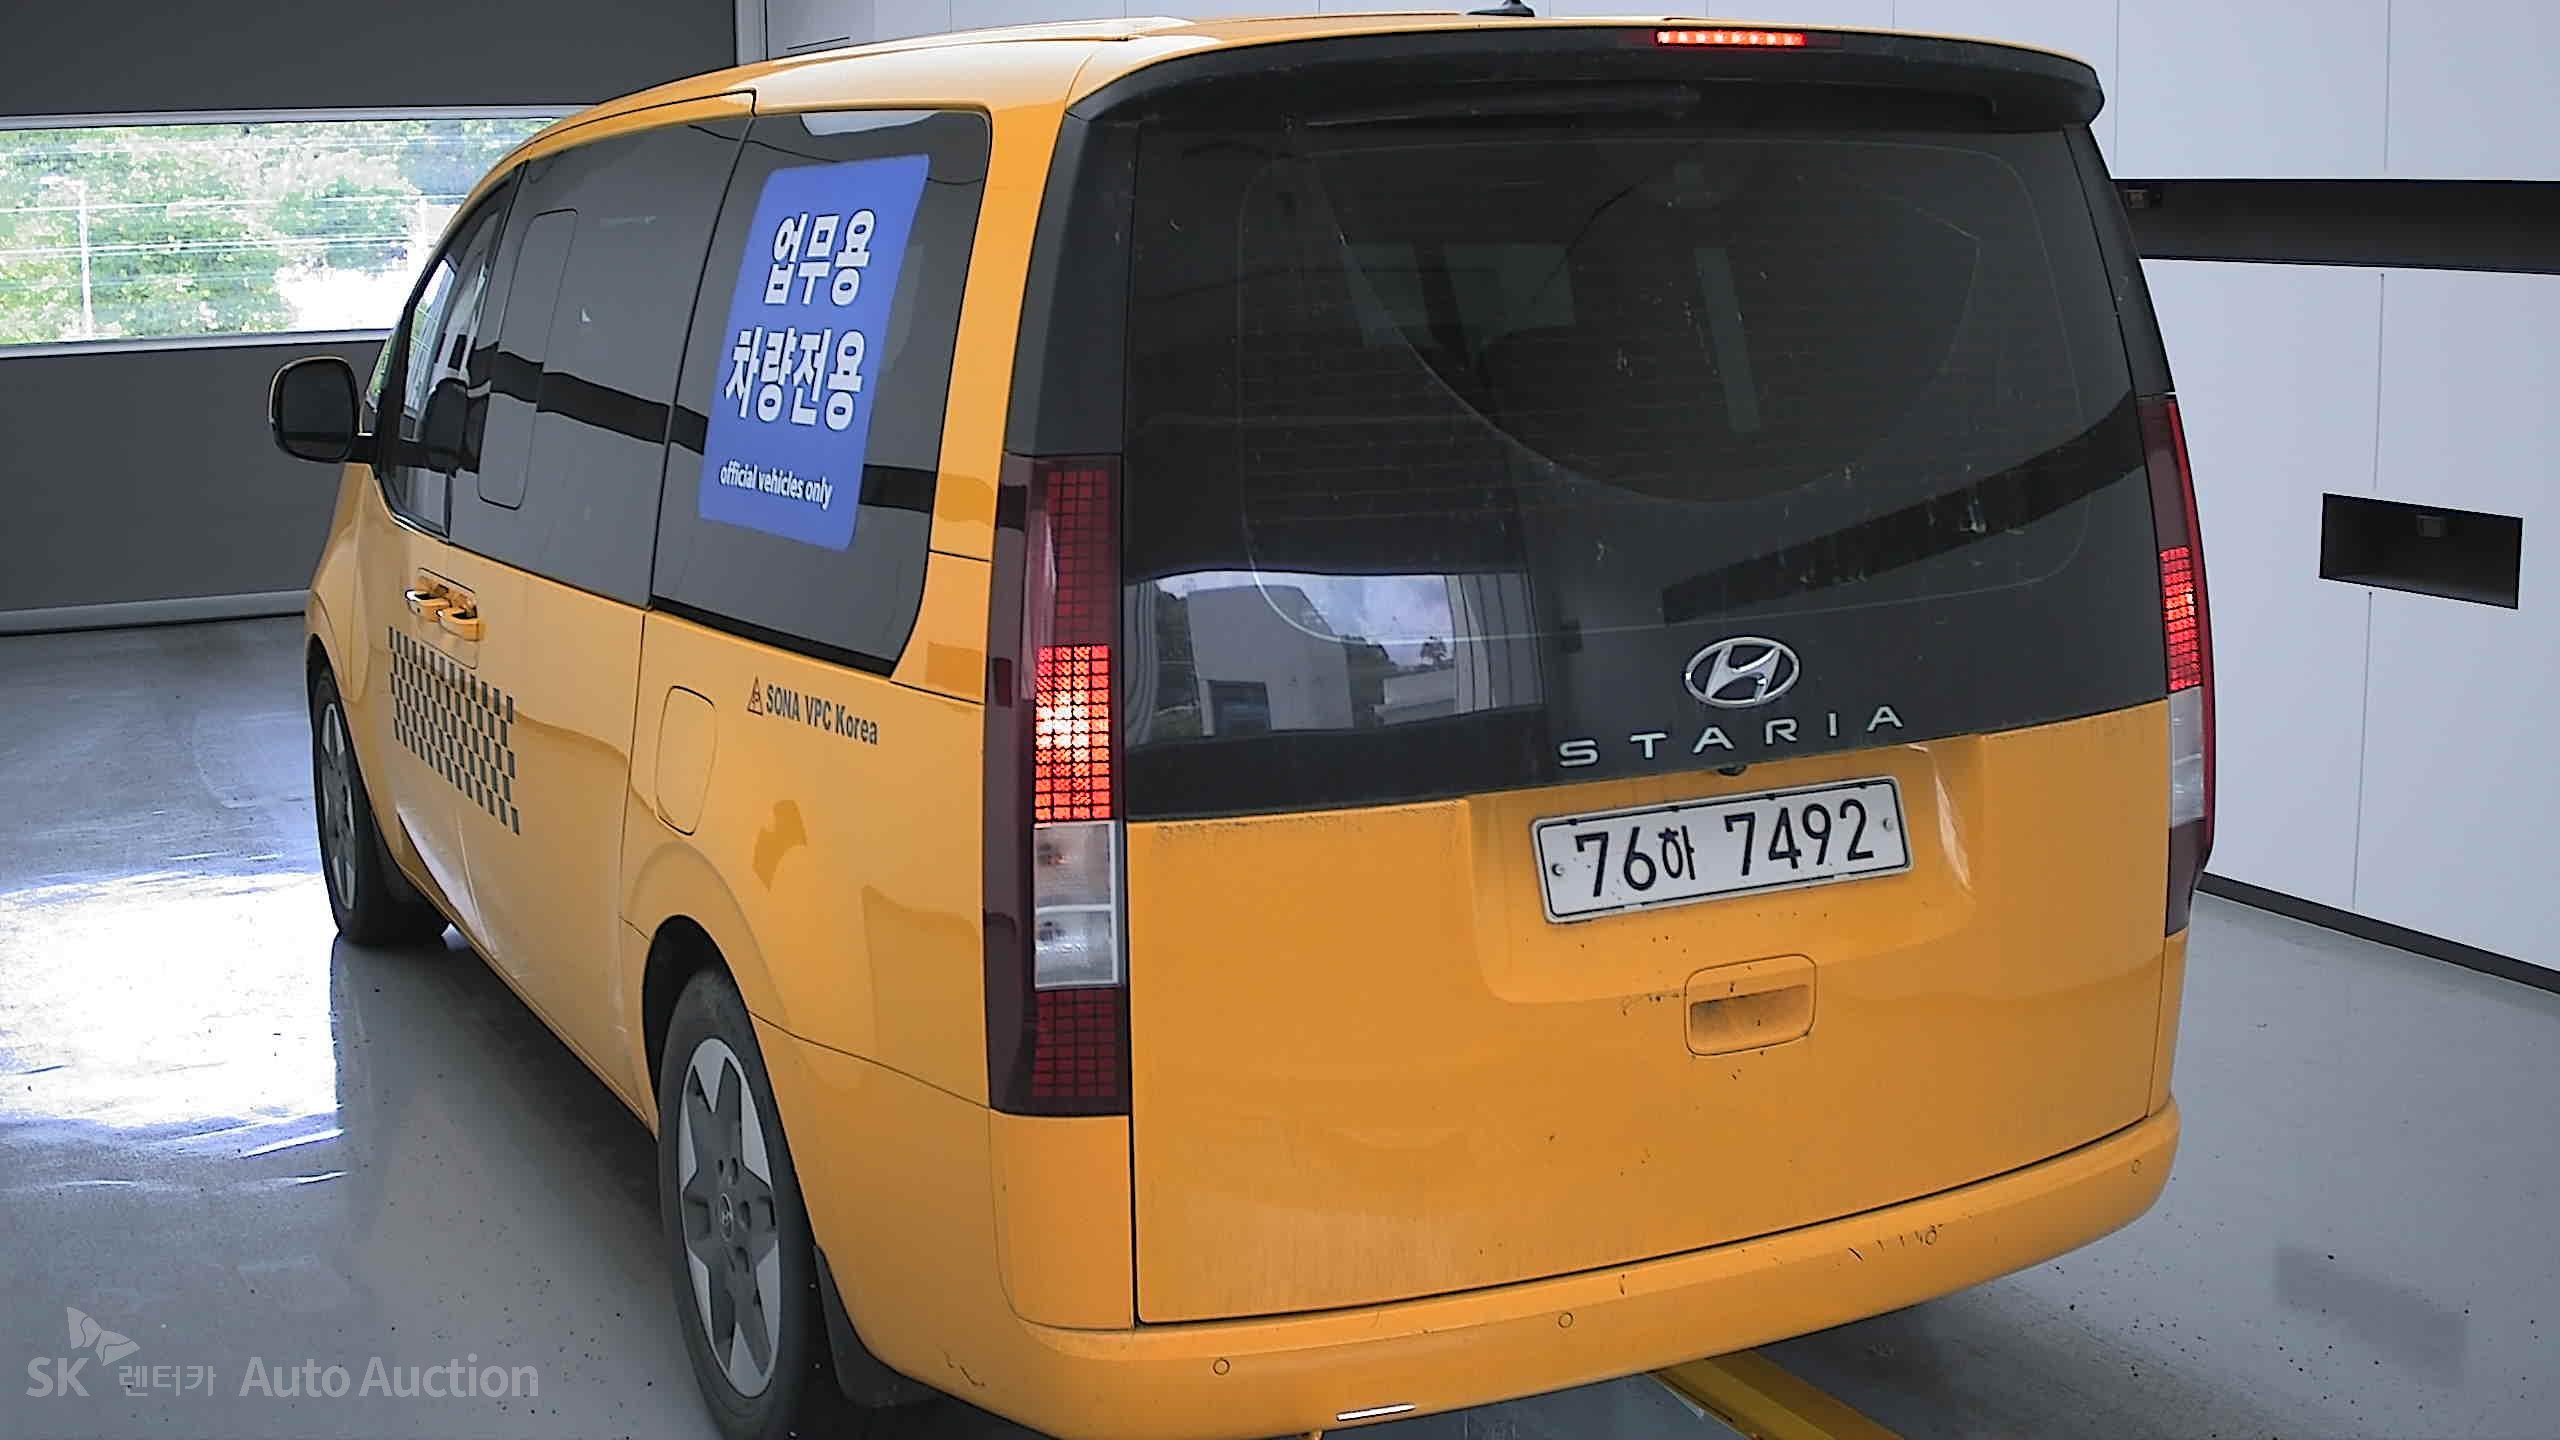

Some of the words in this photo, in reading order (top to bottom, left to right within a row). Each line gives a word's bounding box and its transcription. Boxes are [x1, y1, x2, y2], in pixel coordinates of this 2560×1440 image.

[763, 209, 878, 307] 업무용
[724, 326, 866, 432] 차량전용
[719, 460, 758, 490] official
[758, 467, 804, 499] vehicles
[804, 475, 832, 511] only
[766, 683, 801, 722] SONA
[805, 695, 832, 731] VPC
[835, 703, 878, 745] Korea
[1559, 705, 1903, 767] STARIA
[1575, 824, 1696, 898] 76하
[1724, 798, 1875, 877] 7492
